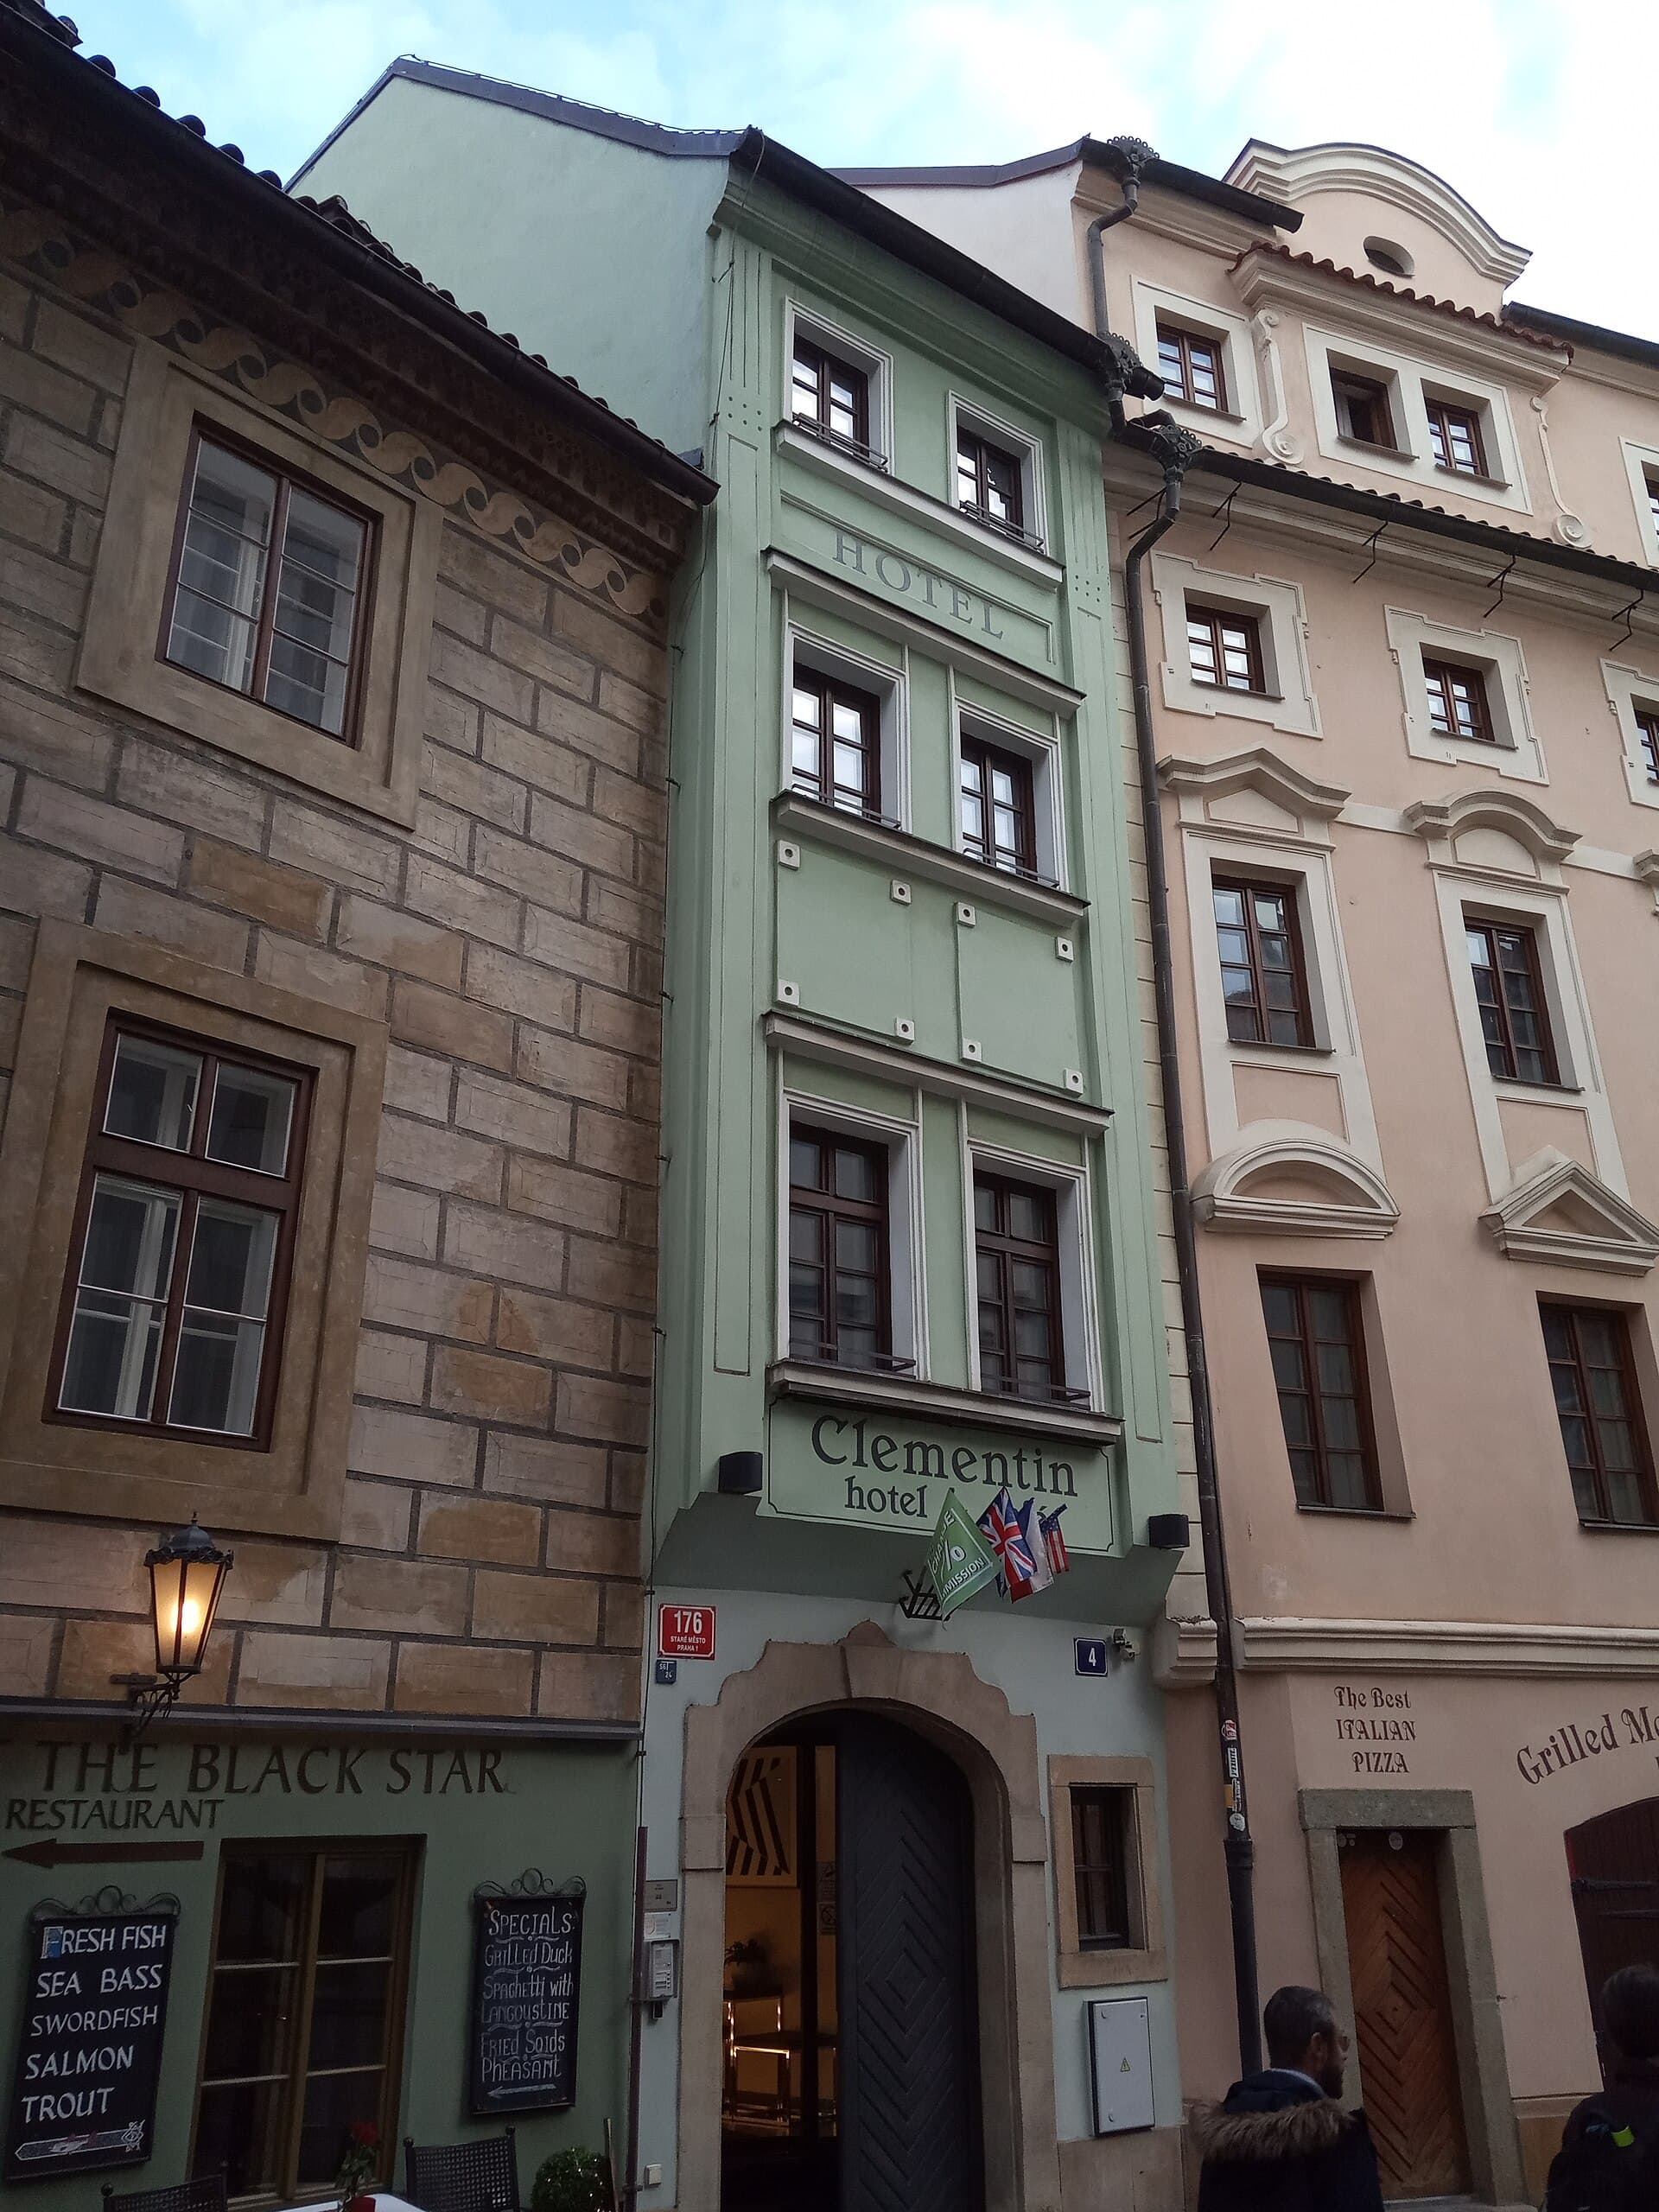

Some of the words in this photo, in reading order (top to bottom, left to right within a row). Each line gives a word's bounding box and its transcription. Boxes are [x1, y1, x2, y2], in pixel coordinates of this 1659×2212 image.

[832, 529, 1003, 640] HOTEL
[810, 1414, 1077, 1497] Clementin
[844, 1475, 928, 1518] hotel
[674, 1610, 702, 1634] 176
[688, 1636, 706, 1644] MĚSTO
[1089, 1647, 1096, 1667] 4
[1333, 1686, 1367, 1710] The
[1370, 1687, 1411, 1709] Best
[1336, 1719, 1416, 1741] ITALIAN
[1351, 1751, 1410, 1773] PIZZA
[1516, 1713, 1620, 1784] Grilled
[37, 1740, 158, 1793] THE
[187, 1743, 368, 1795] BLACK
[386, 1746, 507, 1795] STAR
[5, 1798, 225, 1830] RESTAURANT
[41, 1926, 115, 1960] FRESH
[121, 1924, 167, 1950] FISH
[35, 1970, 82, 1999] SEA
[100, 1964, 163, 1994] BASS
[550, 1972, 574, 1997] with
[30, 2005, 159, 2037] SWORDFISH
[24, 2044, 134, 2081] SALMON
[21, 2087, 115, 2124] TROUT
